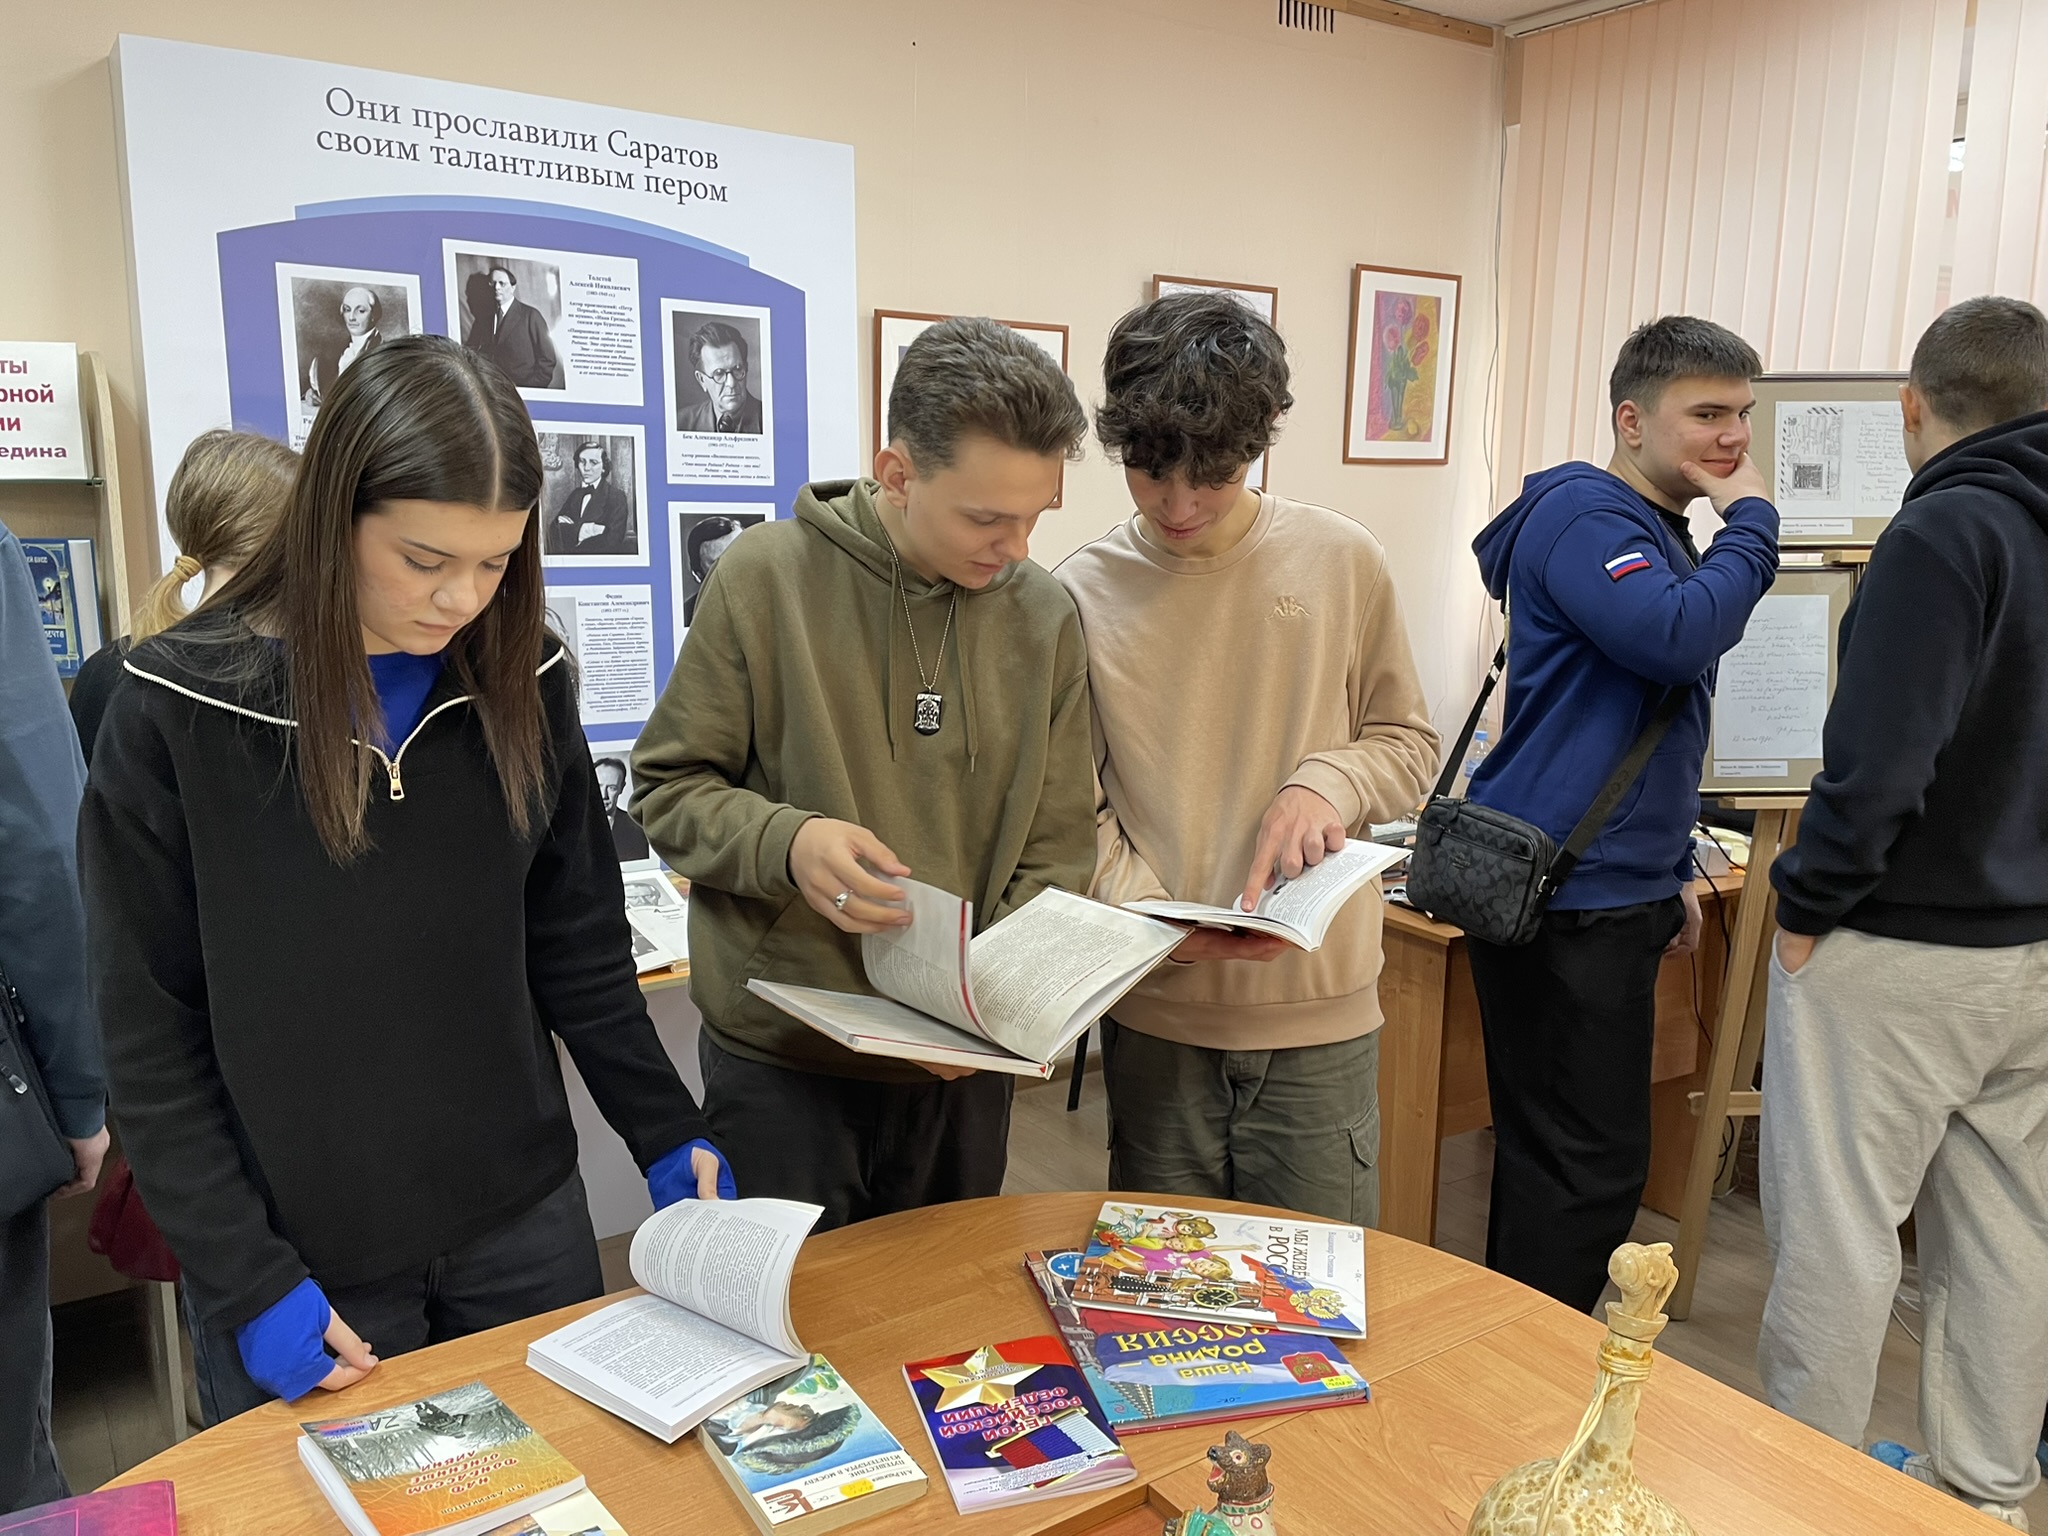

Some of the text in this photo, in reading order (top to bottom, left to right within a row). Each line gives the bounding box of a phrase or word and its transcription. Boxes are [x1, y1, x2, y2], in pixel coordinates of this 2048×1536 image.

[325, 86, 720, 170] Они прославили Саратов
[316, 130, 729, 205] своим талантливым пером
[588, 274, 612, 282] Толстой
[594, 282, 631, 291] Николаевич
[694, 434, 722, 442] Александр
[724, 435, 758, 443] Альфредович
[1262, 1234, 1290, 1299] РОССИИ
[1147, 1338, 1267, 1368] родина
[1178, 1360, 1253, 1381] Наша
[939, 1395, 1083, 1439] РОССИЙСКОЙ
[942, 1386, 1069, 1424] ФЕДЕРАЦИИ
[368, 1414, 400, 1432] ZA
[982, 1414, 1053, 1442] ГЕРОИ
[410, 1452, 500, 1486] ОГНЕННЫЕ
[421, 1450, 476, 1472] ЛИВНИ
[406, 1457, 519, 1495] ДОНБАССОМ
[450, 1476, 490, 1495] НАД
[803, 1471, 837, 1487] МОСКВУ
